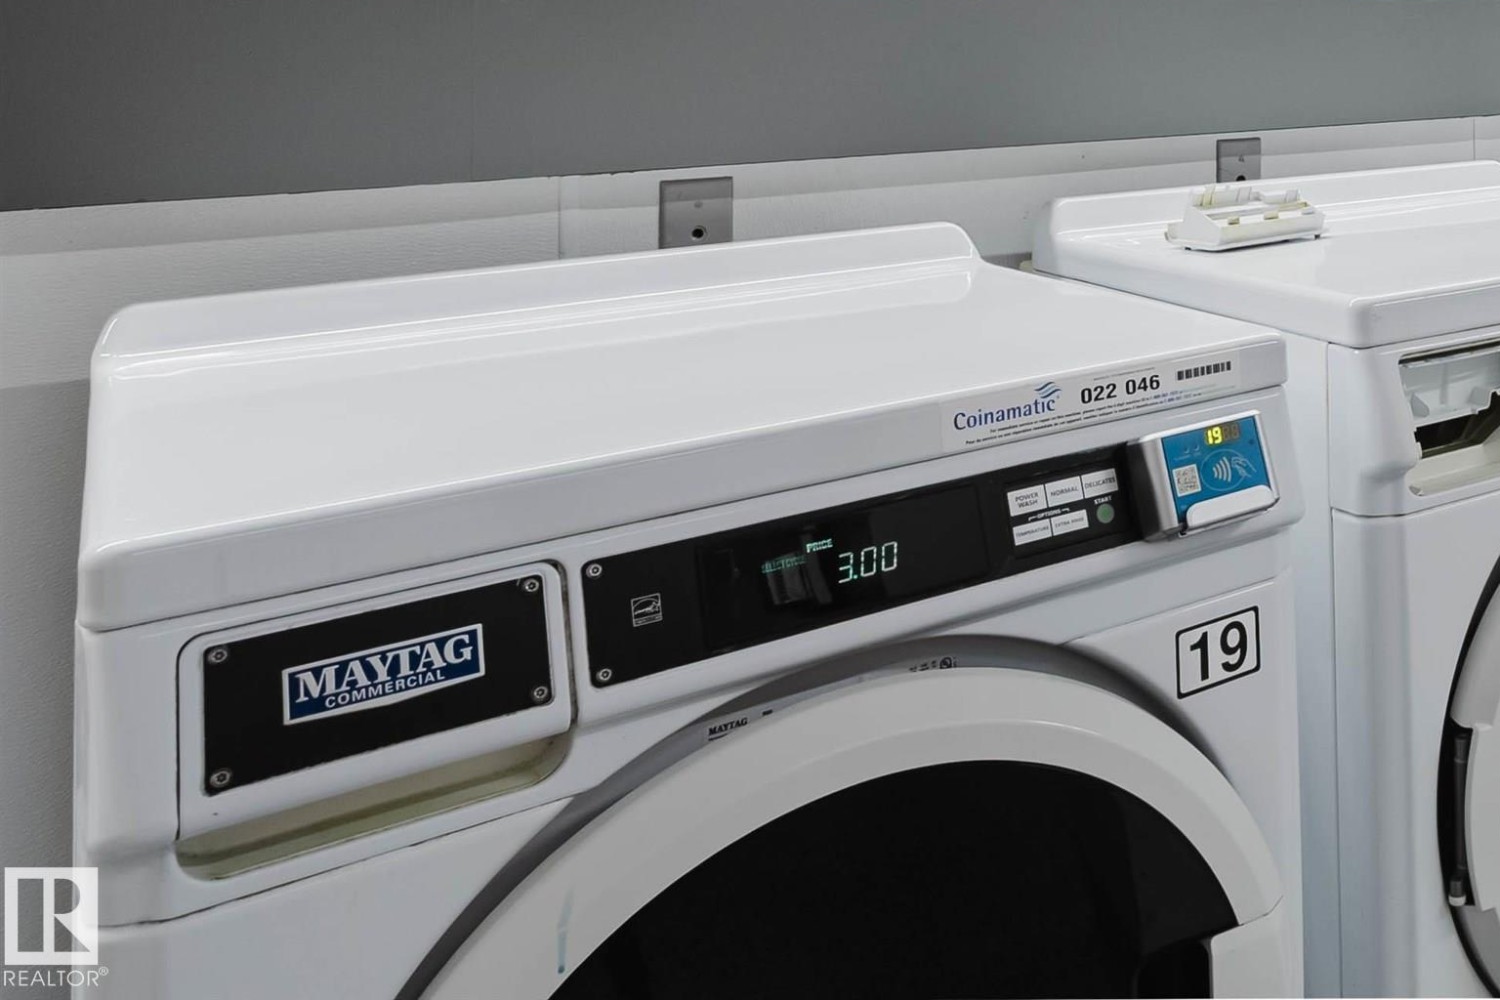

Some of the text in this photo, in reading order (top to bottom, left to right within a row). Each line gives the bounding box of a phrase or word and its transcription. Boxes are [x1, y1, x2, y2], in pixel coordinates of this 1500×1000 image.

[953, 397, 1056, 431] Coinamatic
[1080, 382, 1117, 405] 022
[1125, 374, 1161, 396] 046
[1206, 426, 1223, 445] 19
[1050, 486, 1079, 497] NORMAL
[1084, 476, 1116, 489] DELICATES
[1014, 491, 1039, 502] POWER
[1017, 499, 1038, 509] WASH
[806, 538, 834, 553] PRICE
[838, 541, 898, 584] 3.00
[1189, 620, 1248, 682] 19
[294, 632, 474, 704] MAYTAG
[324, 668, 446, 709] COMMERCIAL
[708, 717, 748, 736] MAYTAG
